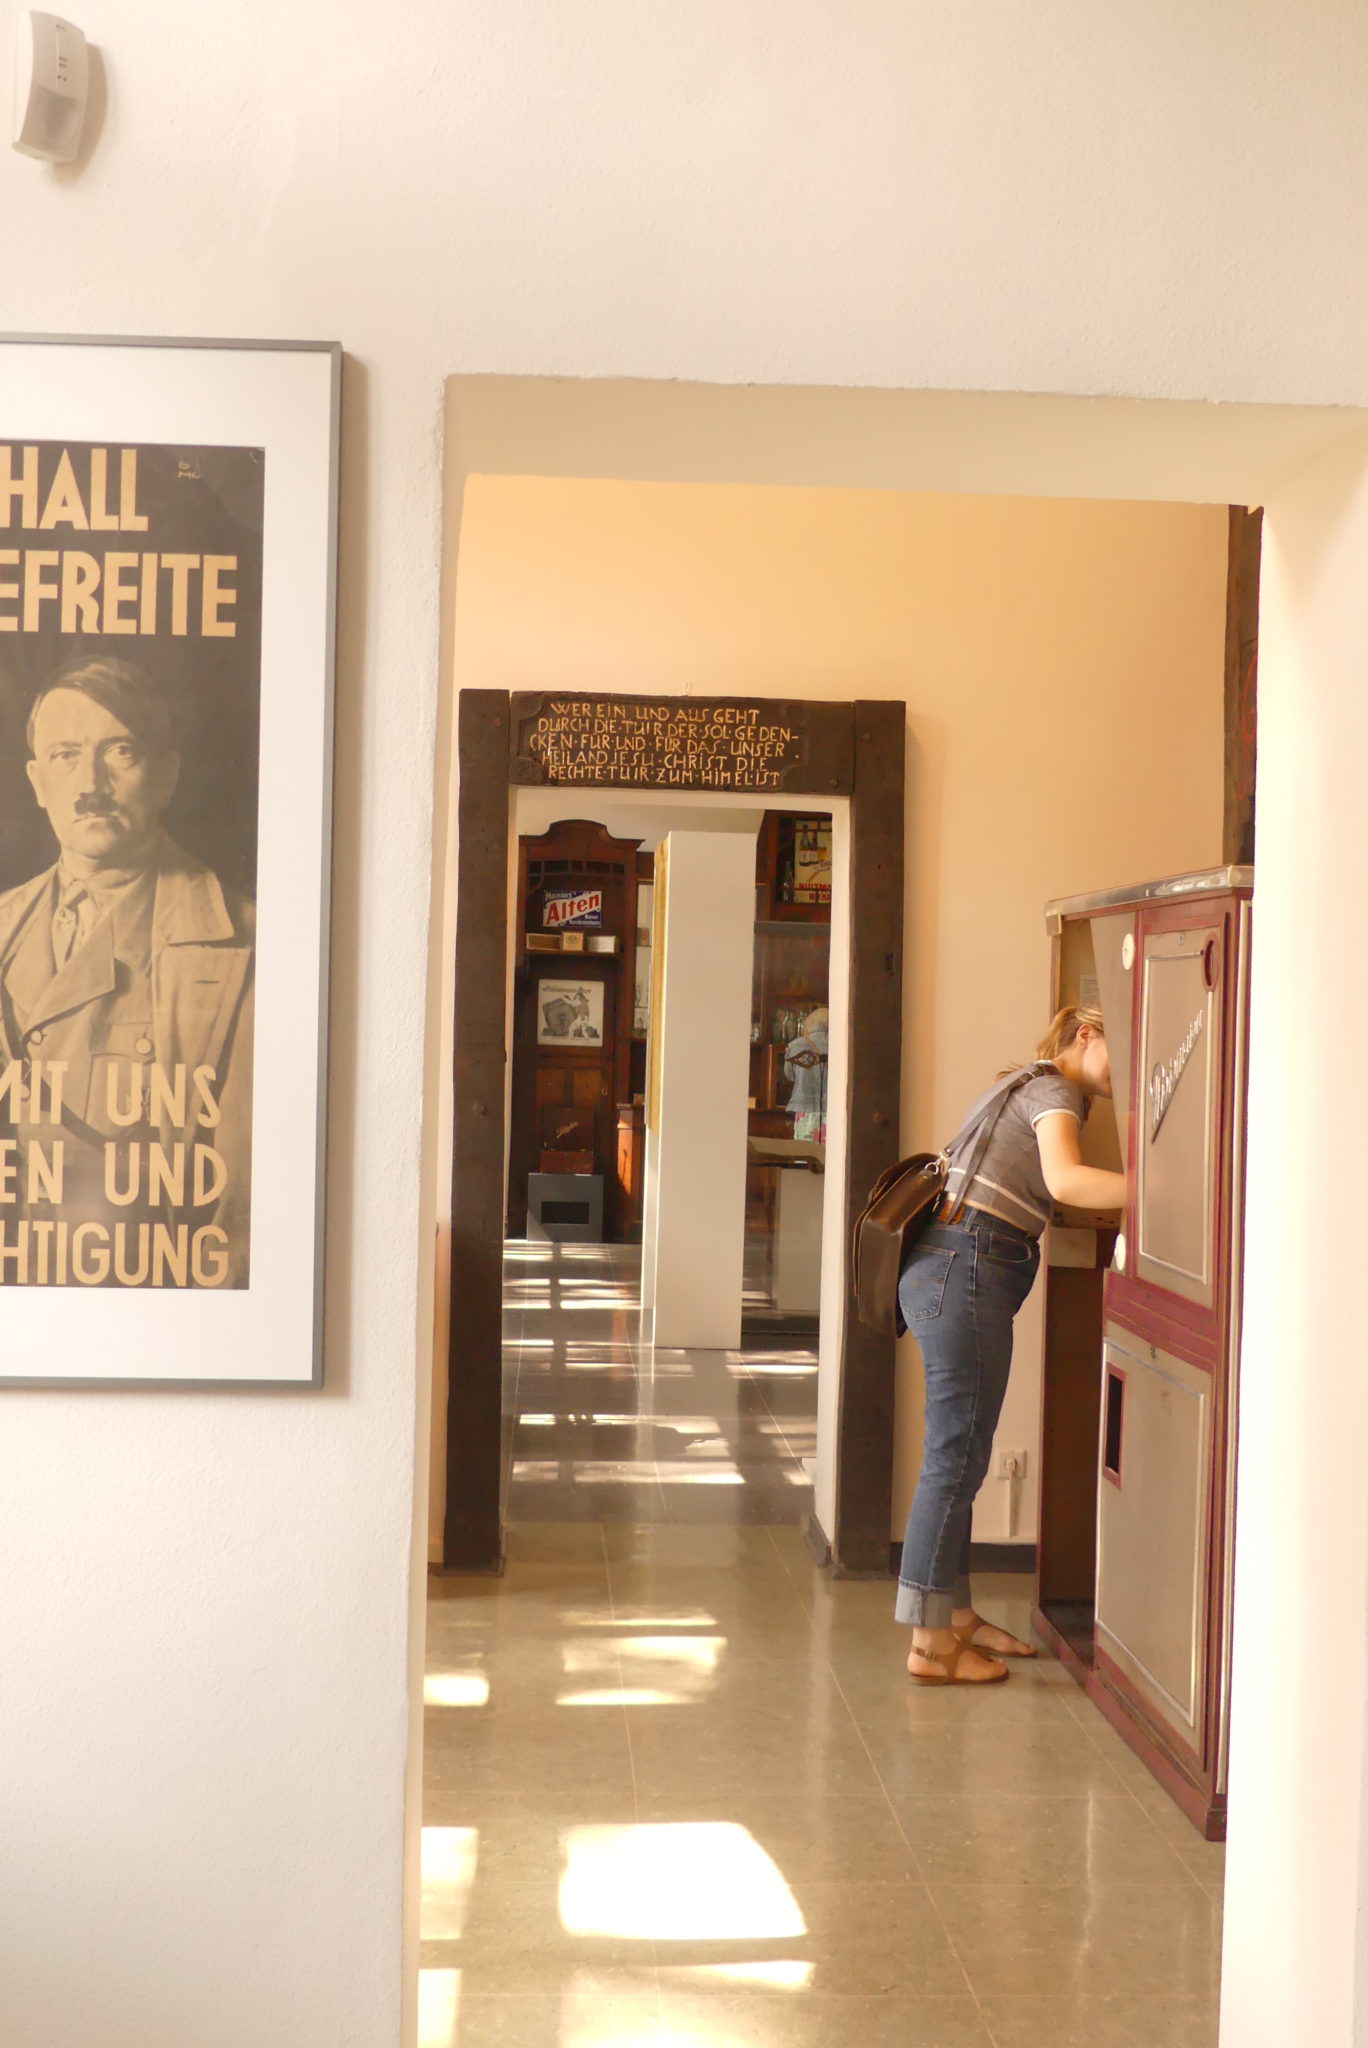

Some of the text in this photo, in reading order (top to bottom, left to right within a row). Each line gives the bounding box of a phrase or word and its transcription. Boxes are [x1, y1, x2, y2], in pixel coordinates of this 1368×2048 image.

[538, 717, 589, 732] DURCH
[550, 702, 759, 725] WER EIN UND AUS GEHT
[730, 741, 785, 757] UNSER
[541, 750, 608, 766] HEILAND
[663, 752, 727, 770] CHRIST
[736, 756, 768, 772] DIE
[106, 1062, 222, 1128] UNS
[104, 1142, 229, 1207] UND
